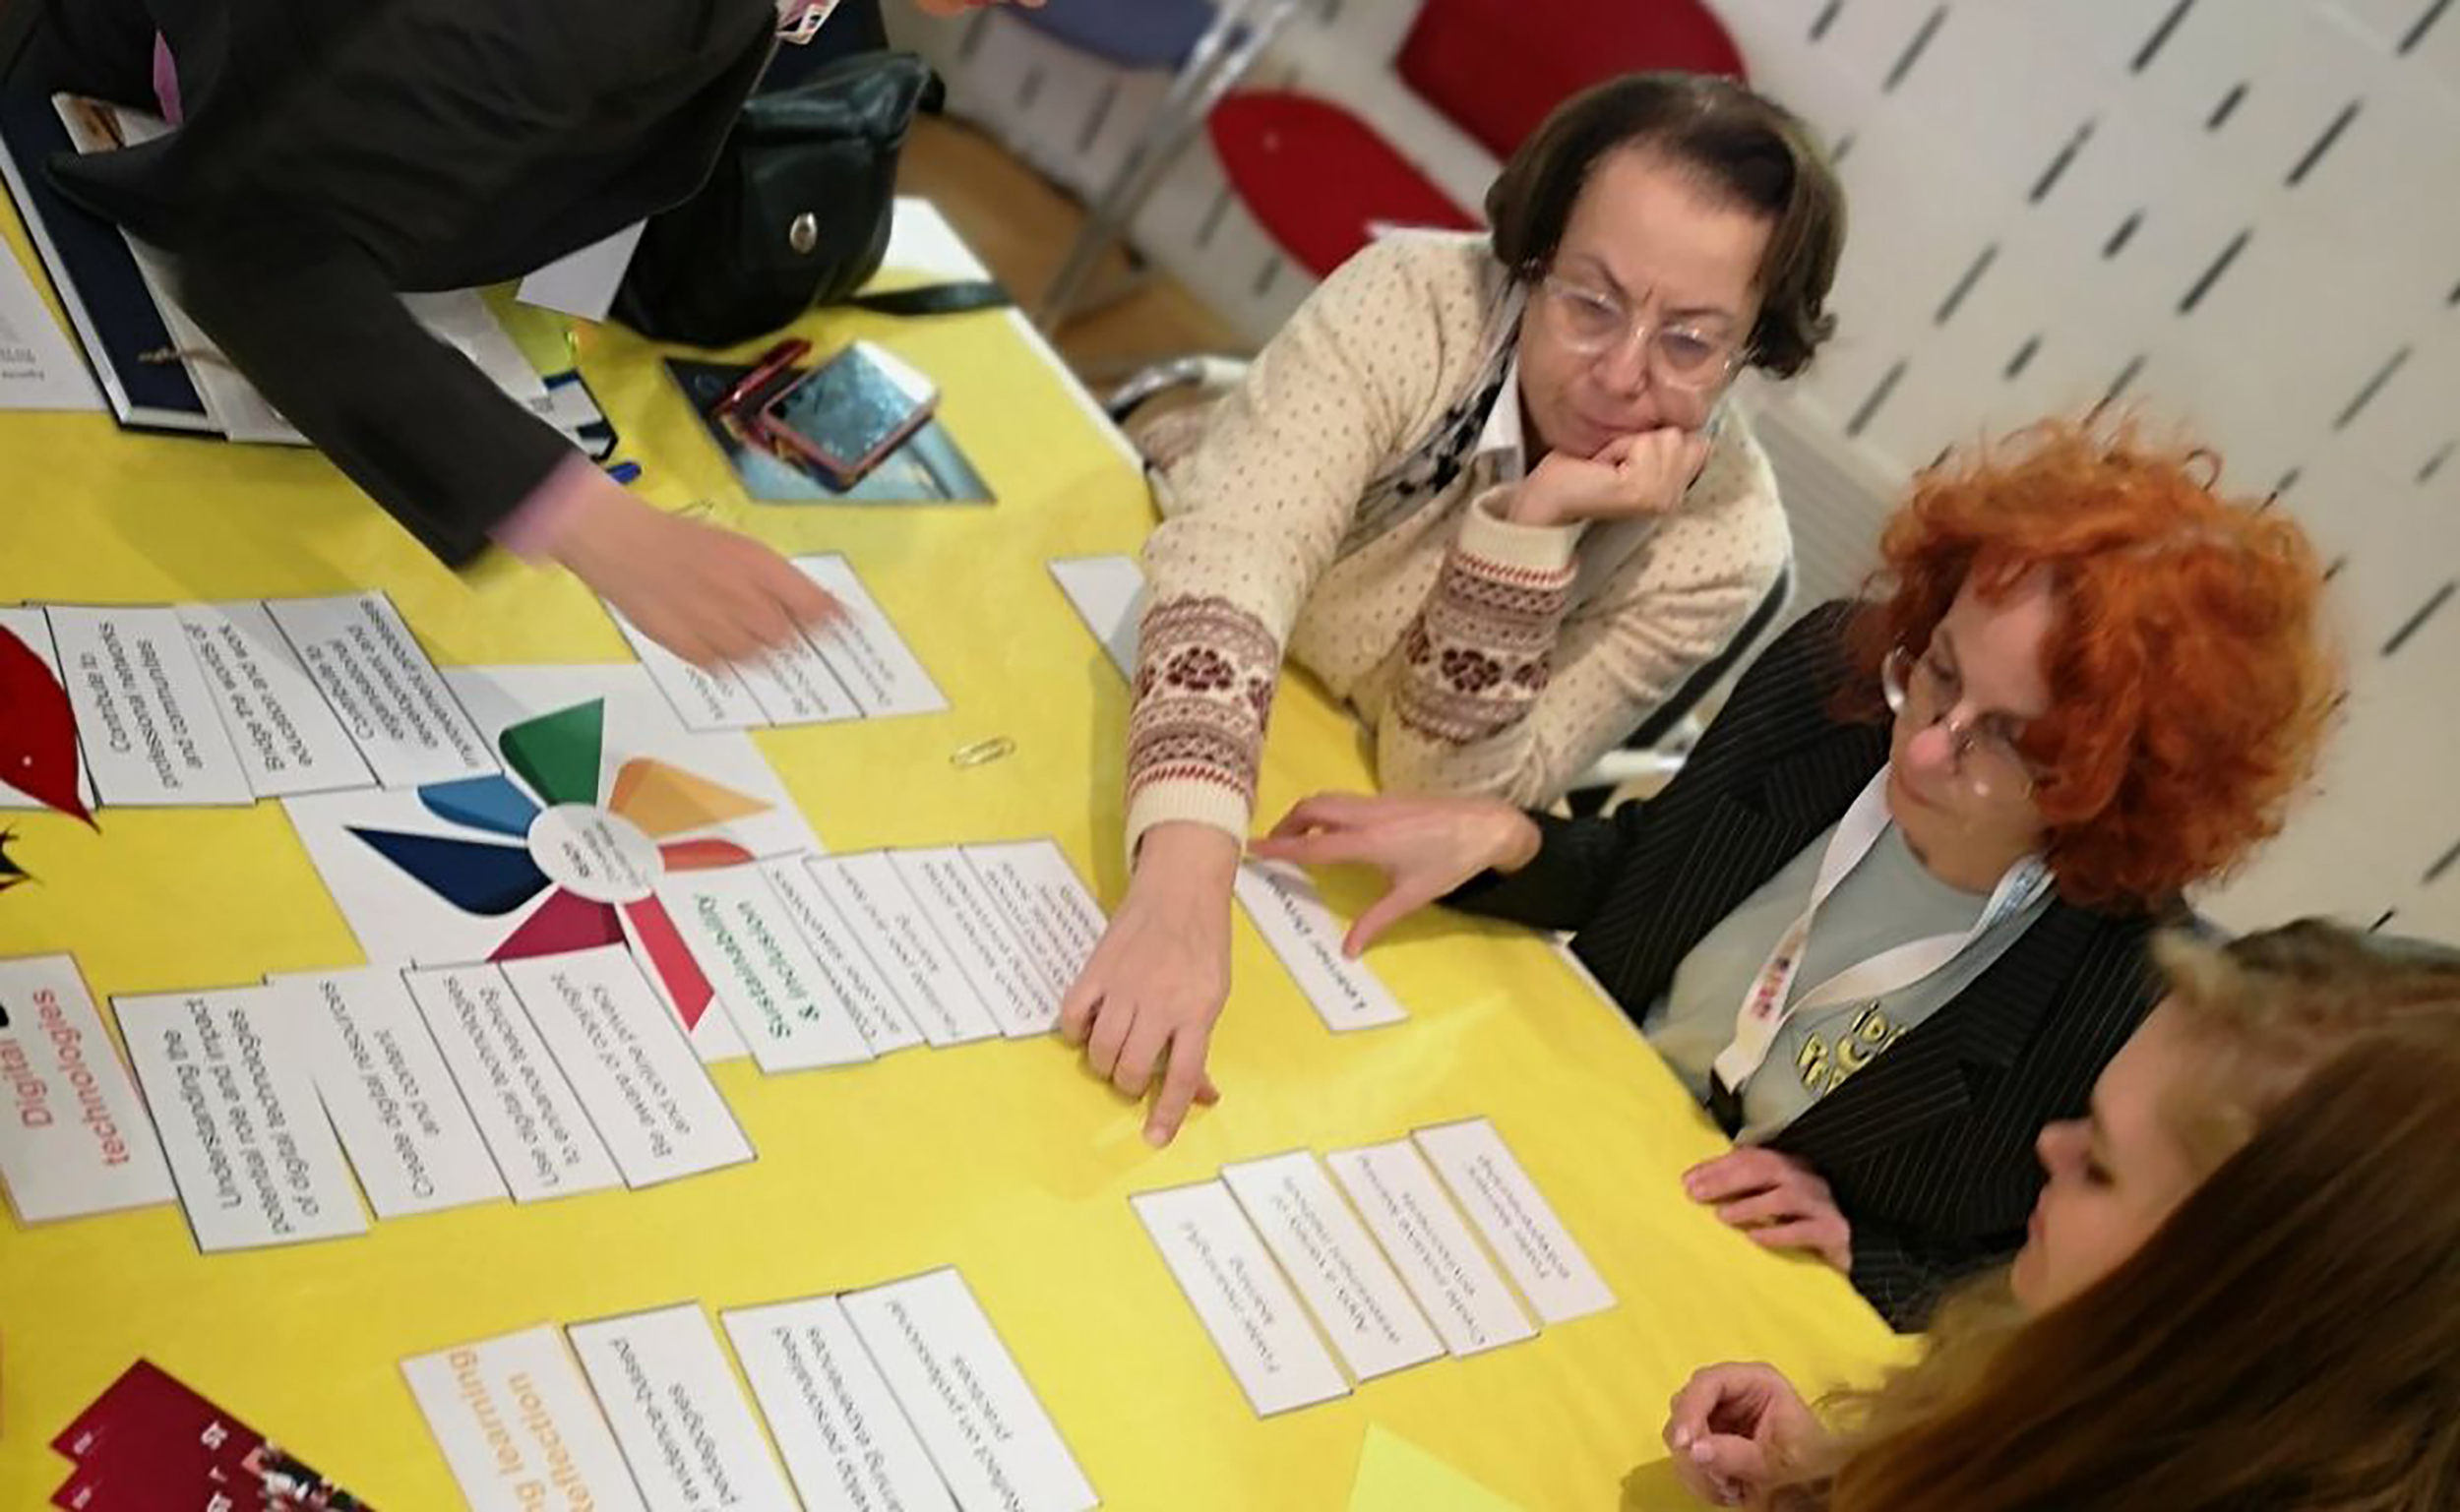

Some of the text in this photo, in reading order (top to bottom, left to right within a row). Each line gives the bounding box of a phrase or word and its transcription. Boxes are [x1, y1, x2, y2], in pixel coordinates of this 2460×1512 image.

[182, 623, 211, 640] of
[235, 661, 270, 691] and
[299, 644, 380, 741] Contribute to
[342, 625, 443, 750] development and
[77, 652, 135, 753] Contribute to
[94, 622, 185, 789] professional networks
[133, 639, 205, 768] and communities
[223, 695, 257, 718] the
[238, 721, 289, 772] Bridge
[253, 693, 317, 768] education
[688, 891, 795, 1040] Sustainability
[732, 899, 823, 1022] & inclusion
[0, 1039, 53, 1128] Digital
[33, 988, 130, 1166] technologies
[156, 1028, 246, 1209] Understanding the
[182, 998, 295, 1235] potential role and impact
[218, 1006, 327, 1217] of digital technologies
[315, 981, 439, 1198] Create digital resources
[369, 1029, 443, 1138] and content
[436, 974, 564, 1186] Use digital technologies
[472, 985, 584, 1166] to enhance teaching
[545, 971, 675, 1159] Be aware of copyright
[654, 1097, 694, 1135] and
[450, 1347, 524, 1475] learning
[605, 1337, 703, 1502] evidence-based
